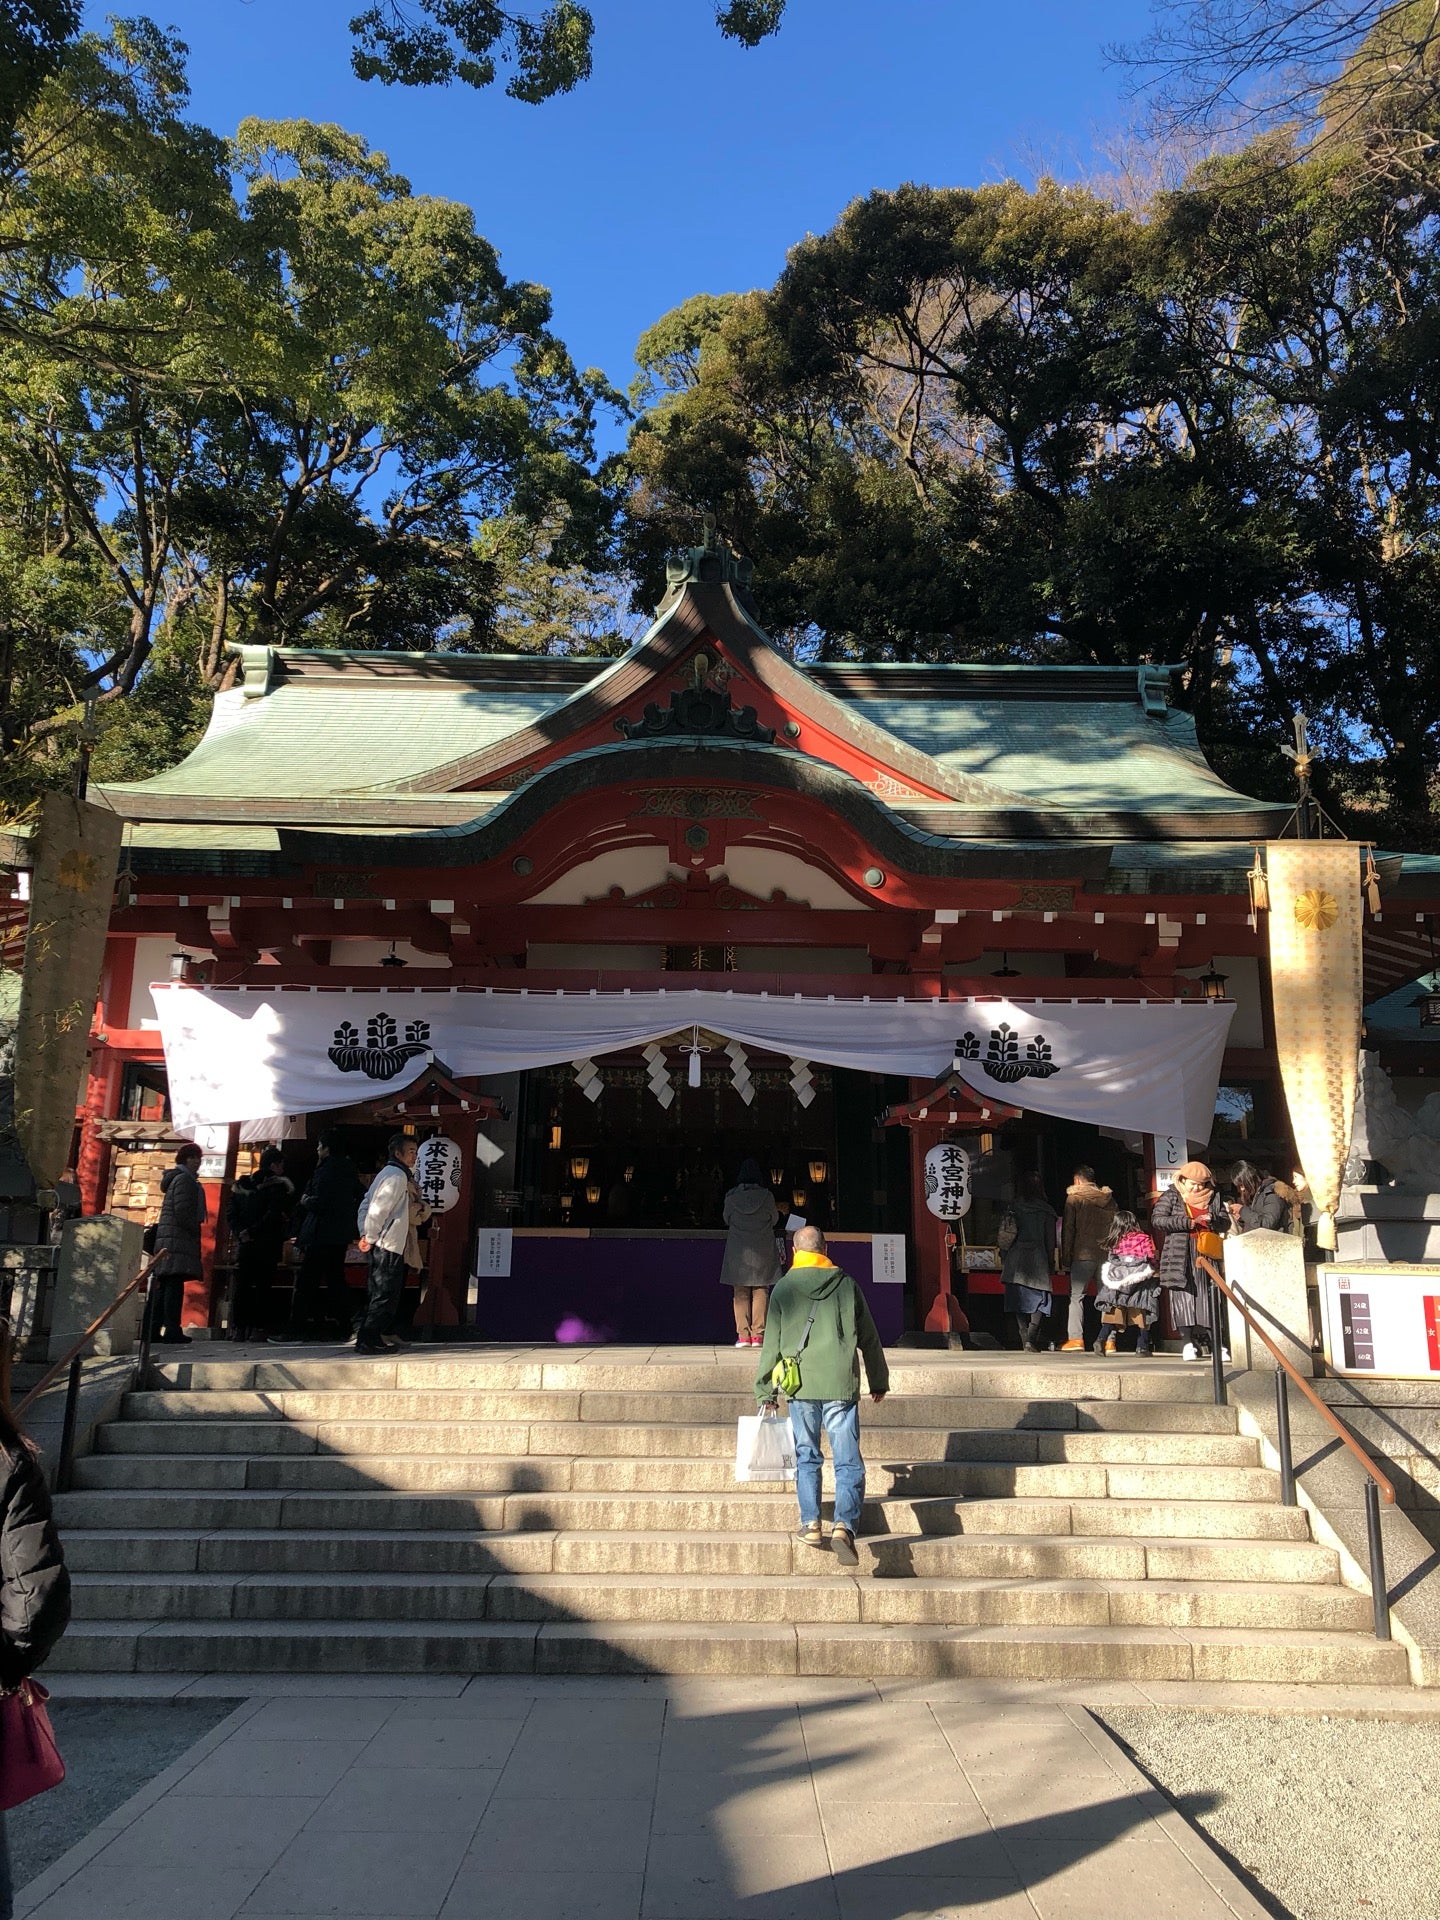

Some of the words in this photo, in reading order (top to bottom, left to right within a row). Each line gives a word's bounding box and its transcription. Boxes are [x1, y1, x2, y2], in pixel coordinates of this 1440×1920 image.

[1166, 1135, 1178, 1164] くじ
[938, 1147, 965, 1216] 來宮神社
[1344, 1325, 1352, 1335] 男
[1427, 1328, 1436, 1337] 女
